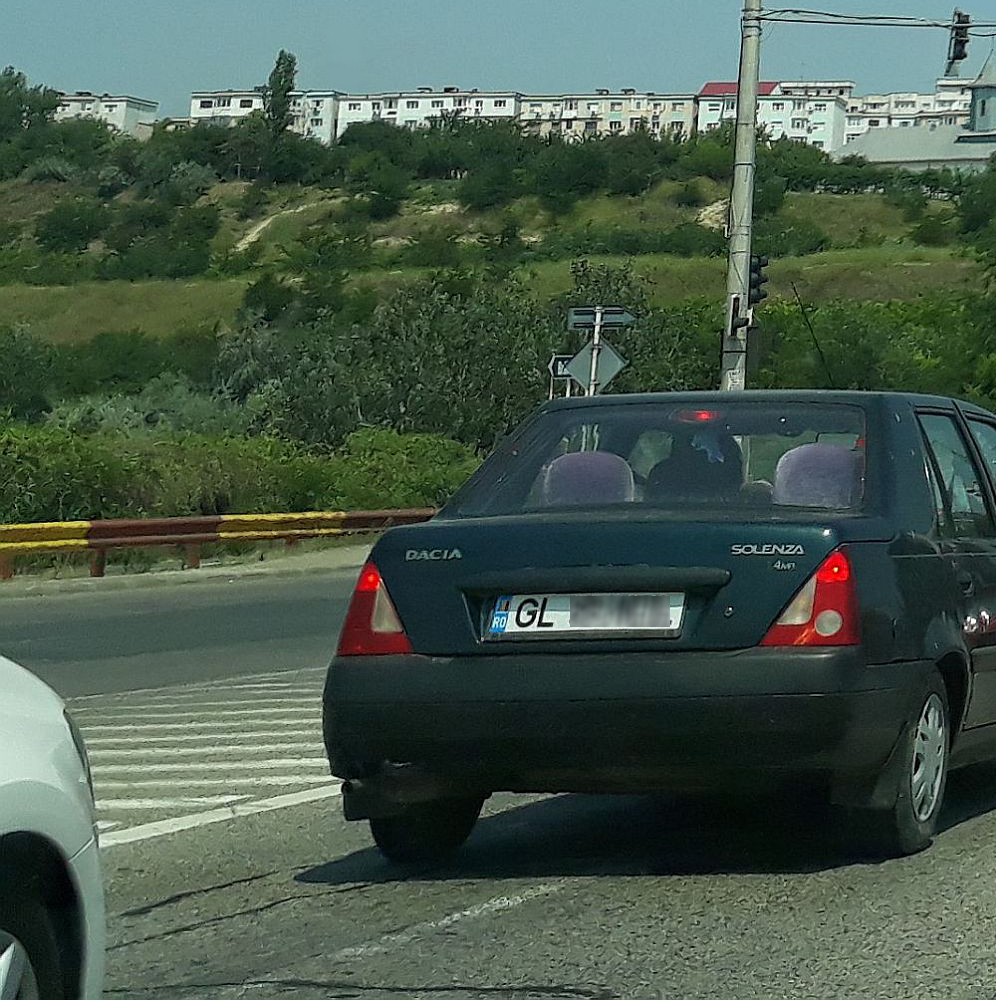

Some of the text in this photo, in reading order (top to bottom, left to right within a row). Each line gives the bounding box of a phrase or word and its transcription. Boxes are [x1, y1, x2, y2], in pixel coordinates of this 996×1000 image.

[405, 548, 463, 561] DACIA
[731, 544, 806, 556] SOLENZA
[515, 597, 554, 628] GL
